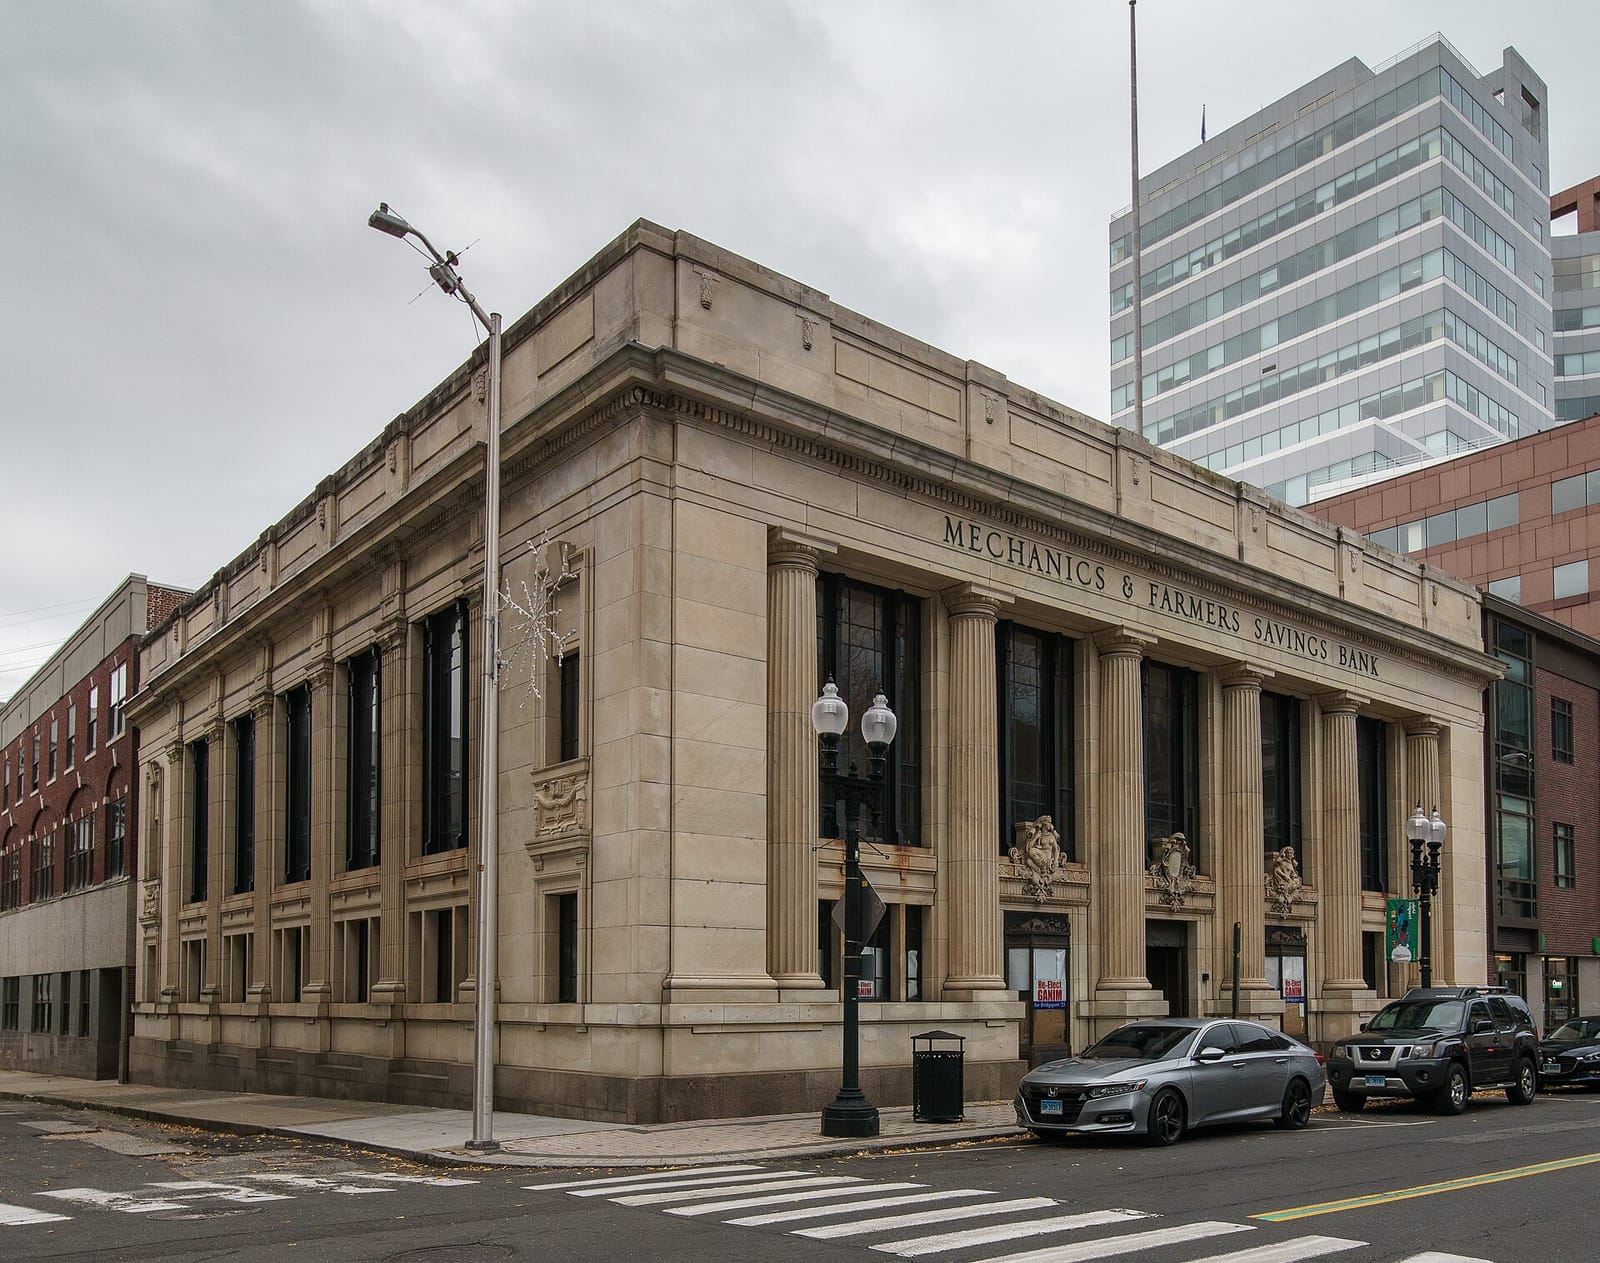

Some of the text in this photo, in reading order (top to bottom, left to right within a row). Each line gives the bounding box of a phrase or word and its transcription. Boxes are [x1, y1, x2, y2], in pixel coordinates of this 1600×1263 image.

[942, 515, 1380, 677] MECHANICS & FARMERS SAVINGS BANK
[1038, 980, 1062, 989] Re-Elect
[1038, 990, 1062, 1000] GANIM
